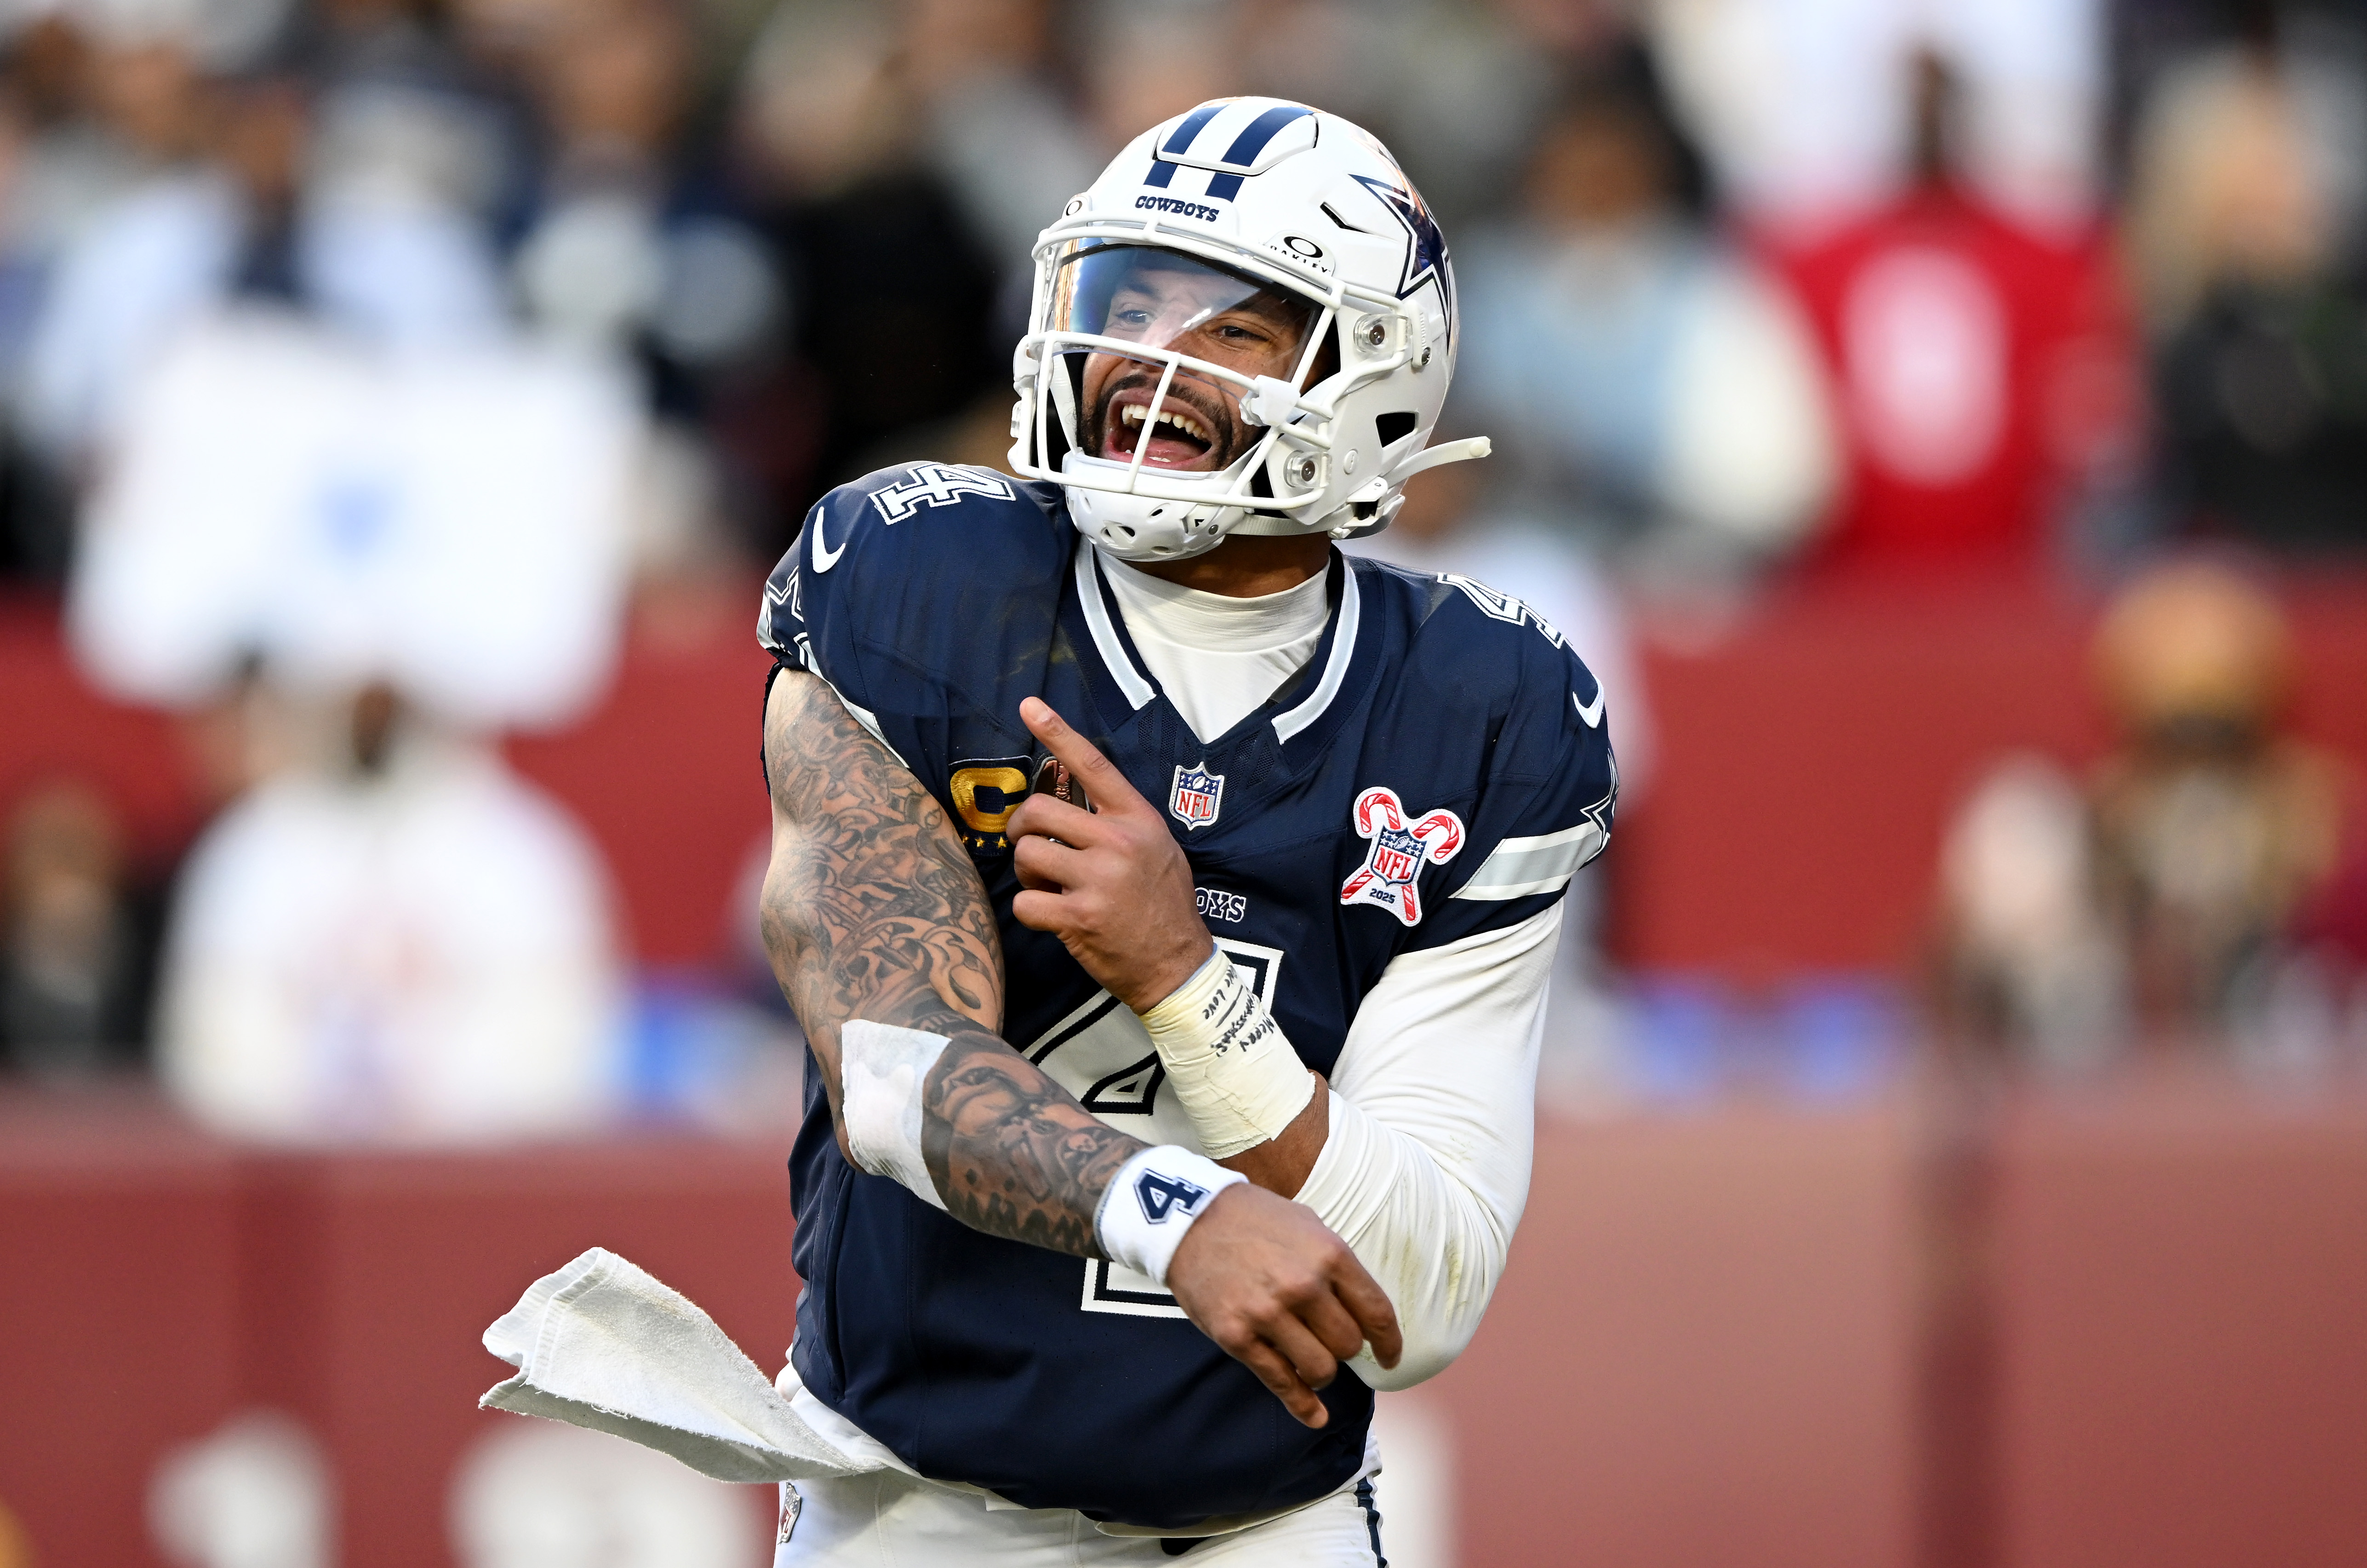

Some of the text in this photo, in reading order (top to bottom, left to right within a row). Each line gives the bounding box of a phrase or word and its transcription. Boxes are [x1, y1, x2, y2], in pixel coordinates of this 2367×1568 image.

[1135, 195, 1220, 222] COWBOYS
[868, 462, 1016, 526] 4
[950, 767, 1027, 833] C
[1177, 790, 1211, 818] NFL
[1374, 847, 1412, 879] NFL
[1369, 888, 1396, 904] 2025
[1133, 1167, 1211, 1225] 4
